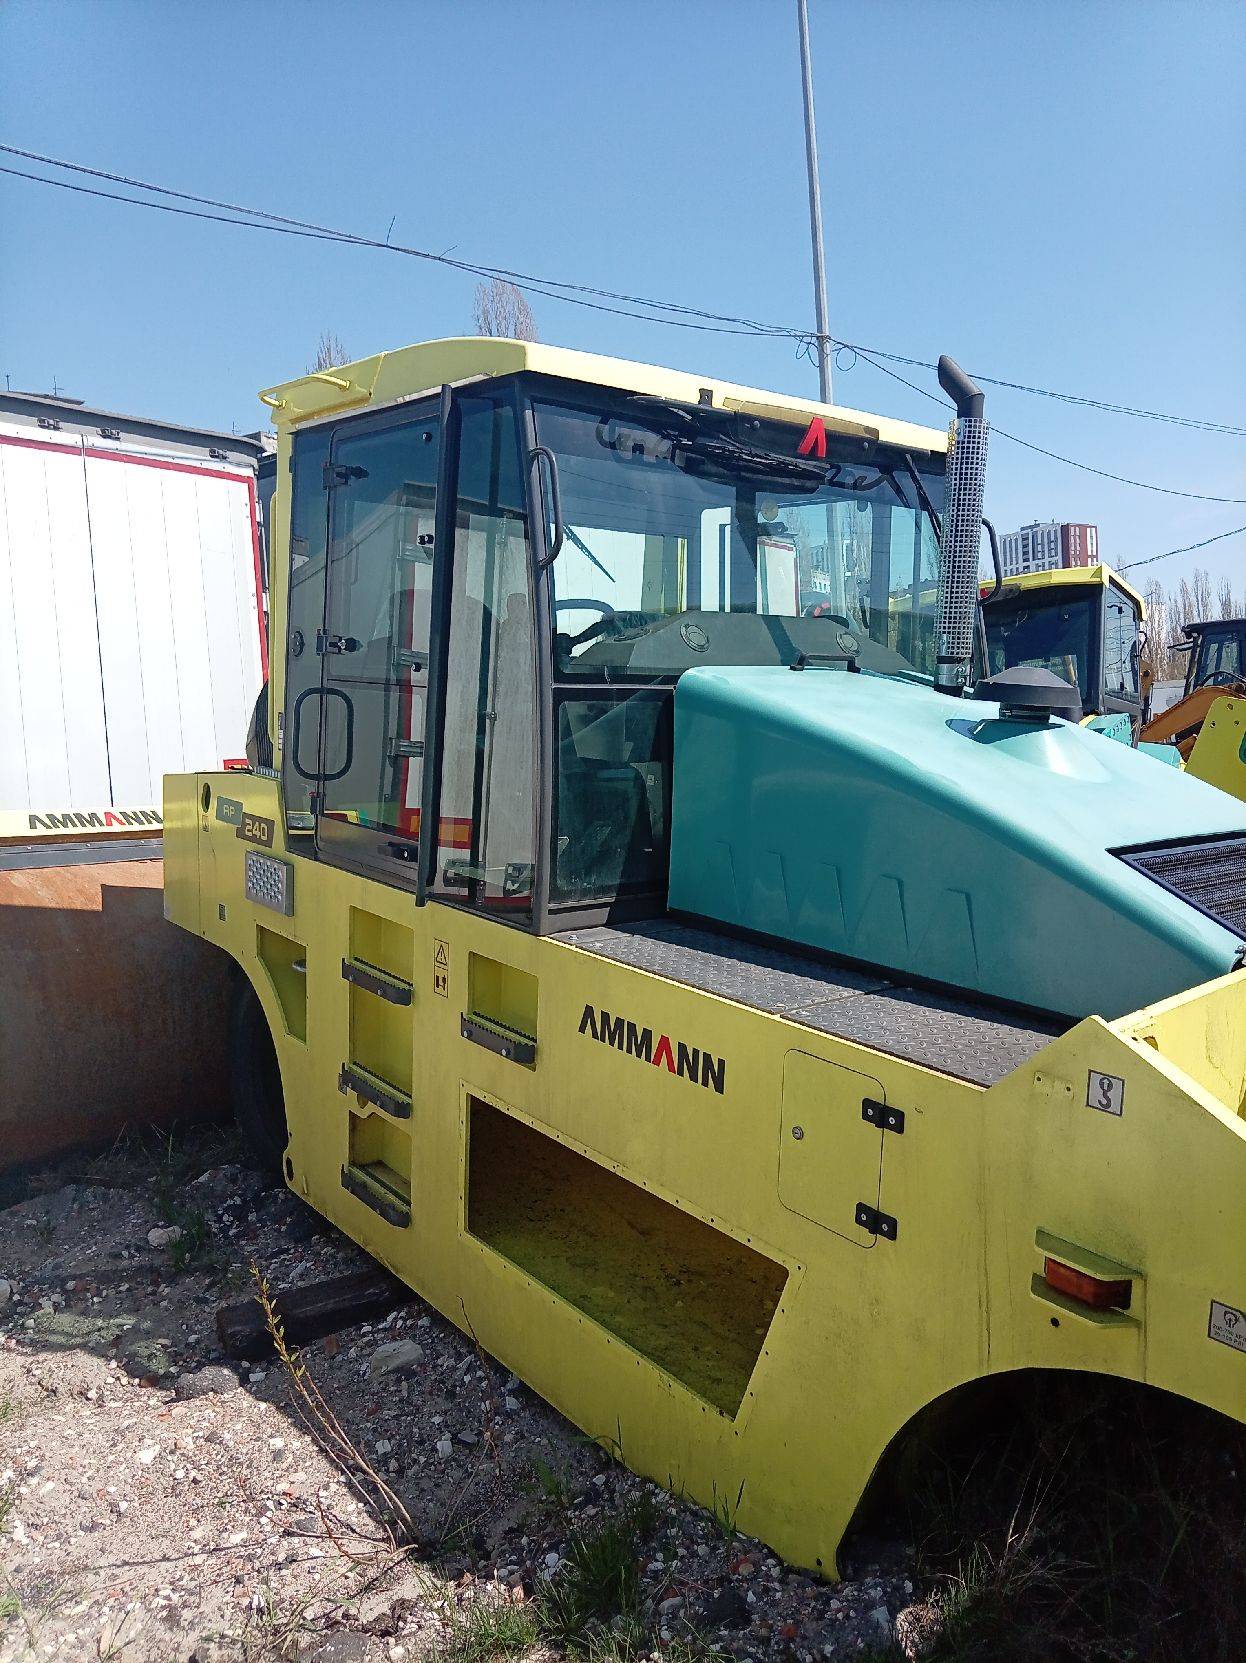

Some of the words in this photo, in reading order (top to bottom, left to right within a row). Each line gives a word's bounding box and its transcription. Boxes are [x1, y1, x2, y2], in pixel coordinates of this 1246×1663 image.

[28, 810, 164, 830] AMMANN
[245, 818, 268, 841] 240
[578, 1003, 726, 1095] AMMANN
